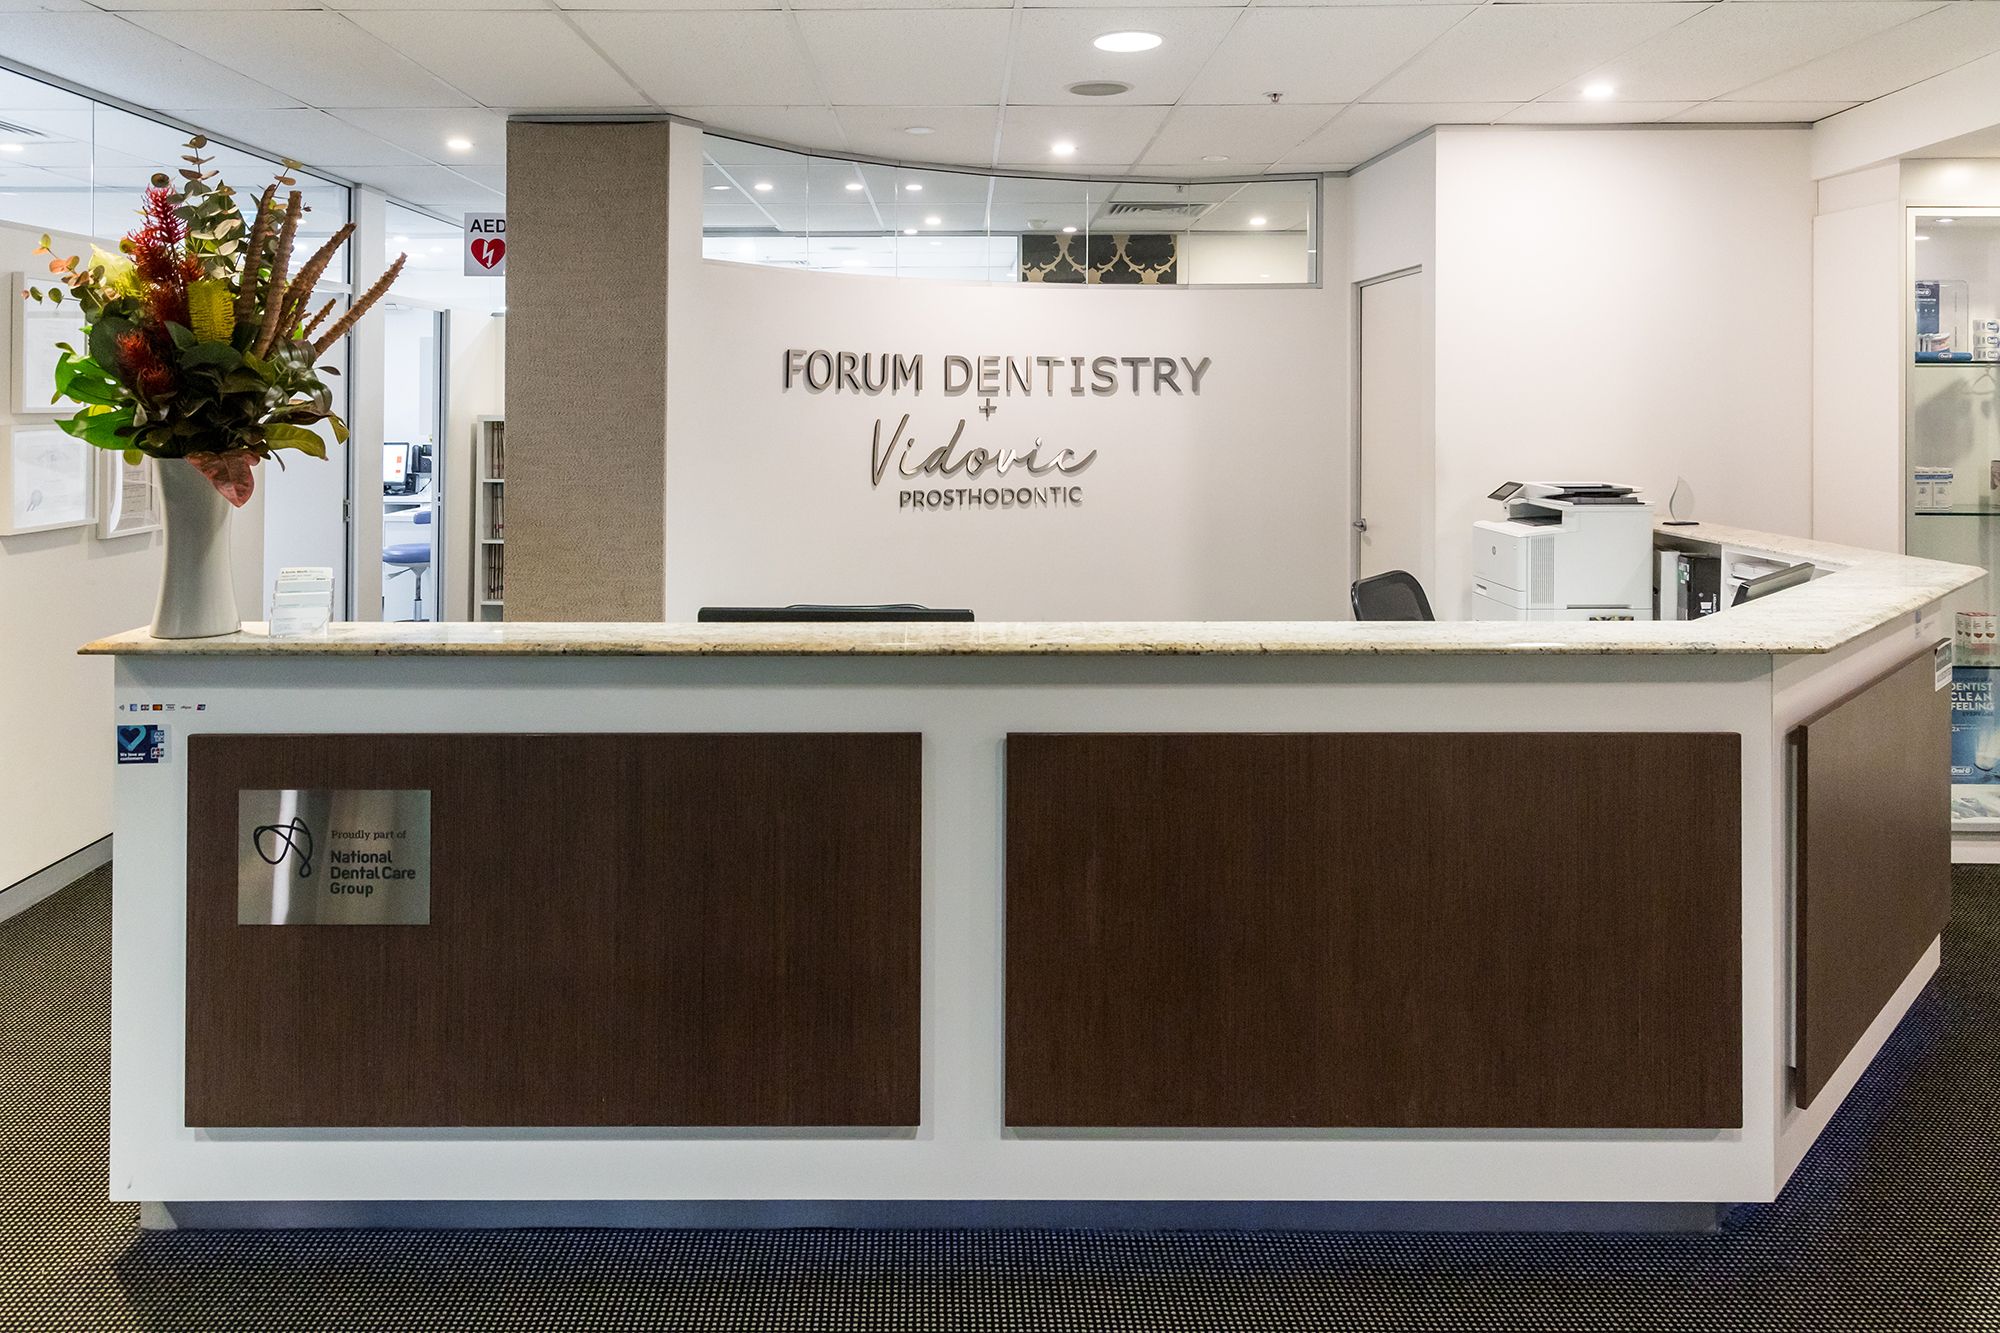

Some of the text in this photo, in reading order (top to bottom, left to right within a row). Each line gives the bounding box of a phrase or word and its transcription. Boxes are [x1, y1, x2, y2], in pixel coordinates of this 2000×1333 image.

[470, 219, 505, 232] AED
[784, 349, 1211, 395] FORUM DENTISTRY
[871, 413, 1098, 486] Vidovic
[899, 486, 1083, 508] PROSTHODONTIC
[1951, 692, 1992, 701] CLEAN
[1951, 702, 1994, 711] FEELING
[331, 830, 407, 841] Proudly part of
[330, 850, 393, 863] National
[330, 867, 416, 879] Dental Care
[330, 883, 374, 897] Group
